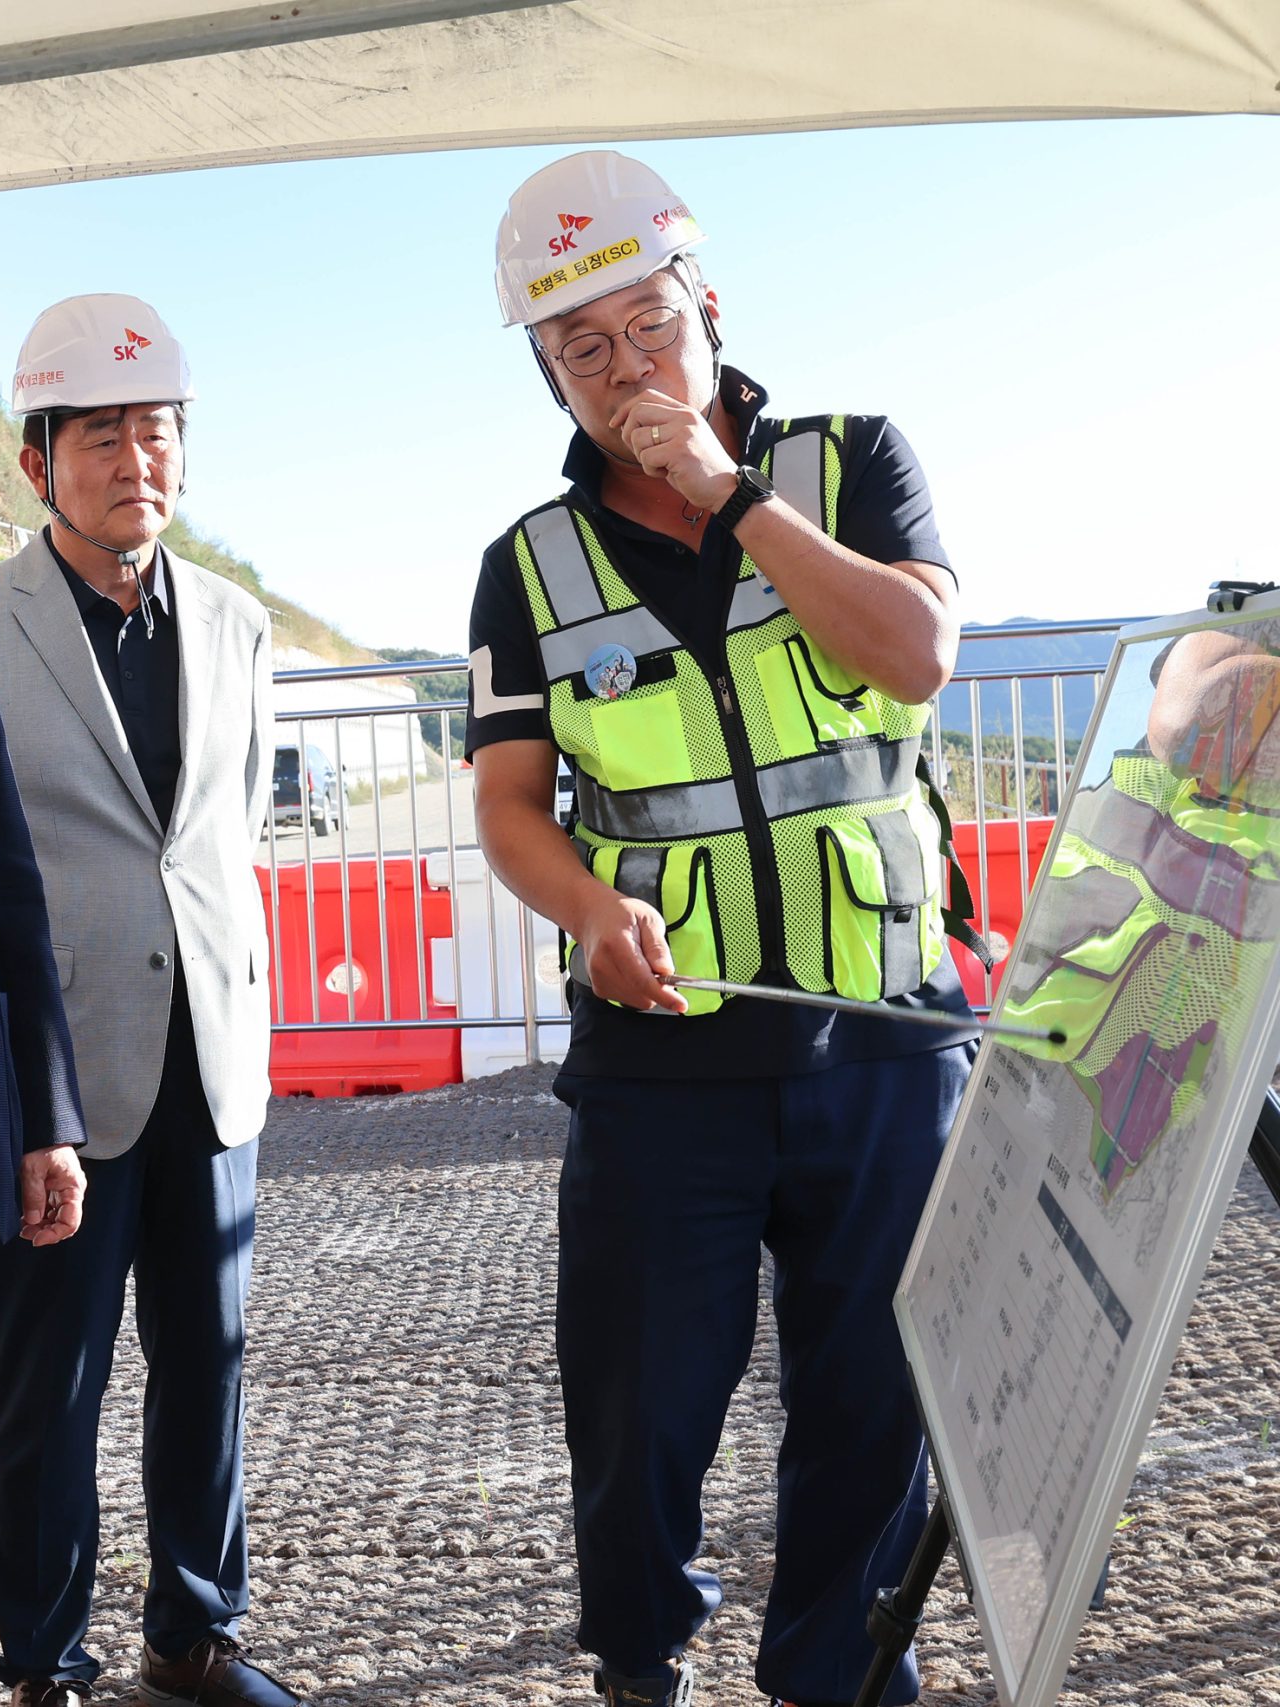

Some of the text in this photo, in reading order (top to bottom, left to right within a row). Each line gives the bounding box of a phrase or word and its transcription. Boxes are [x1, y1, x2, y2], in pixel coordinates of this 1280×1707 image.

[548, 231, 579, 257] SK
[528, 239, 641, 299] 조병욱 팀장(SC)
[113, 345, 138, 361] SK
